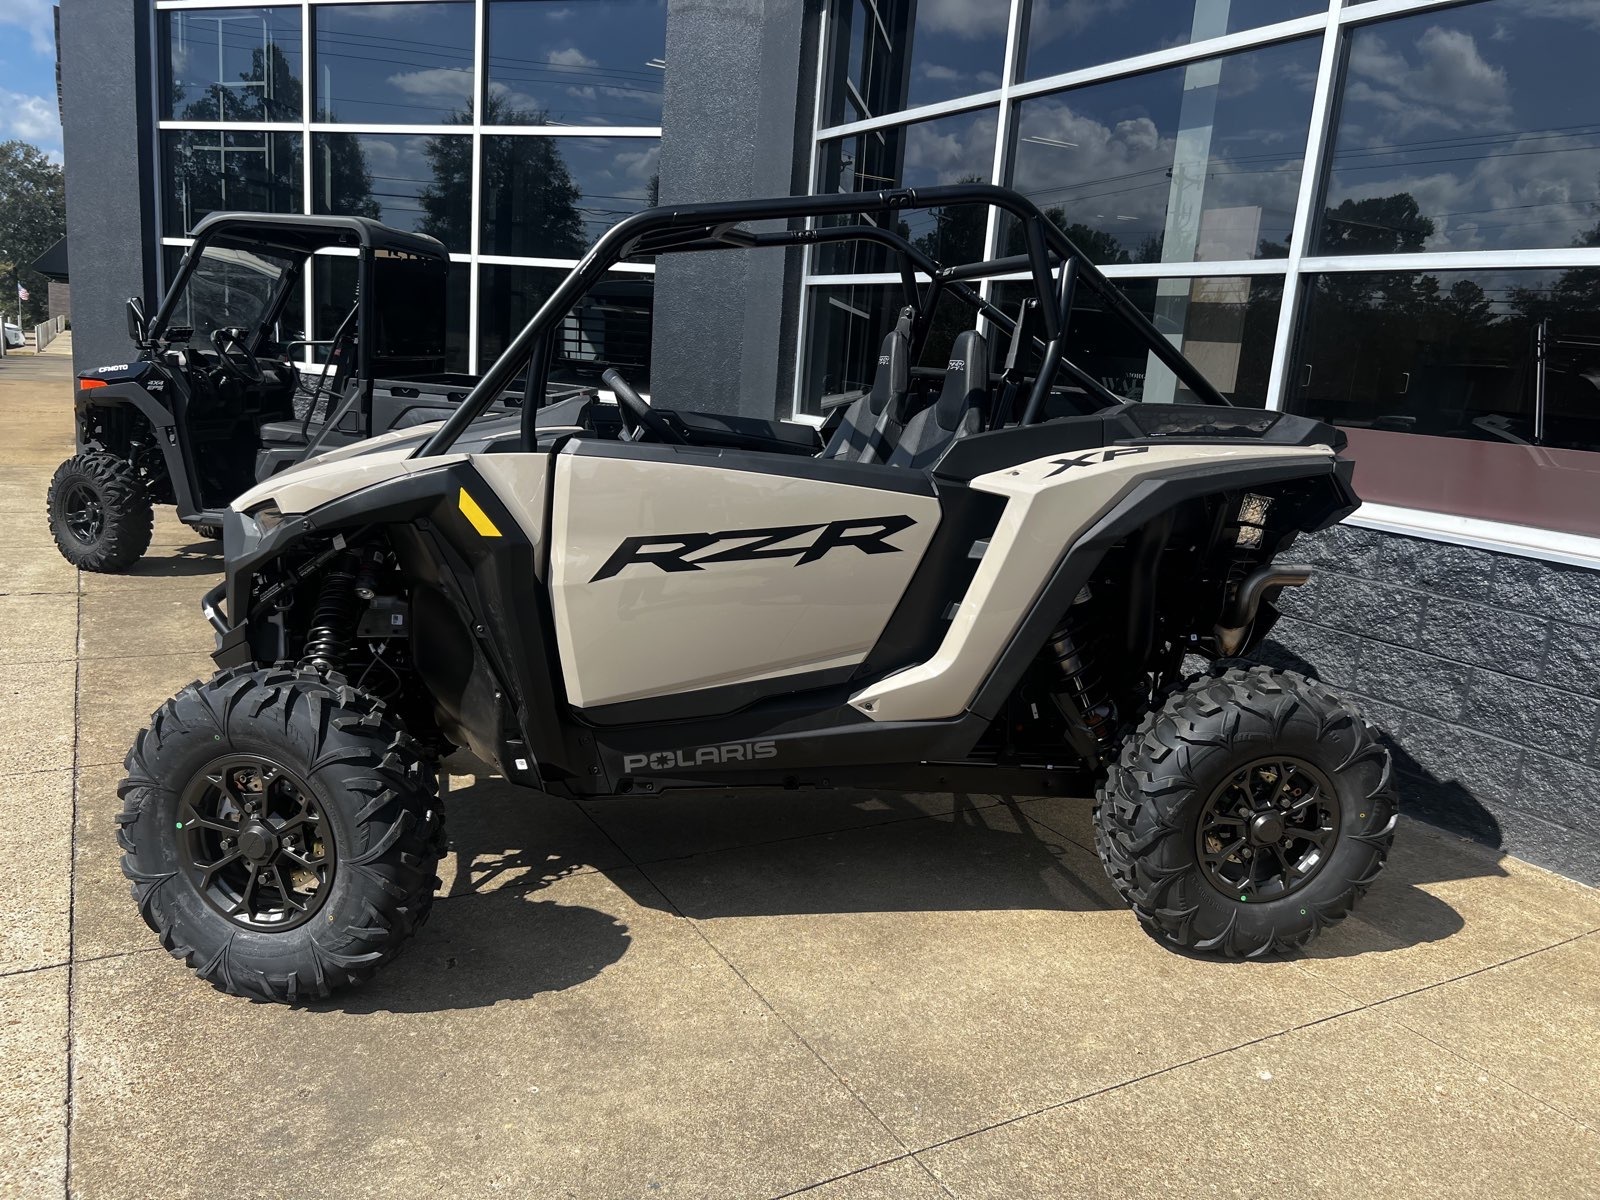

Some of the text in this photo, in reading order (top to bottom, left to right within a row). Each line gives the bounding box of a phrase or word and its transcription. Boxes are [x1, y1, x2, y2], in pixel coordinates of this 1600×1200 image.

[98, 364, 128, 373] CFMOTO
[1042, 447, 1149, 479] XP
[588, 514, 918, 583] RZR
[623, 740, 778, 773] POLARIS
